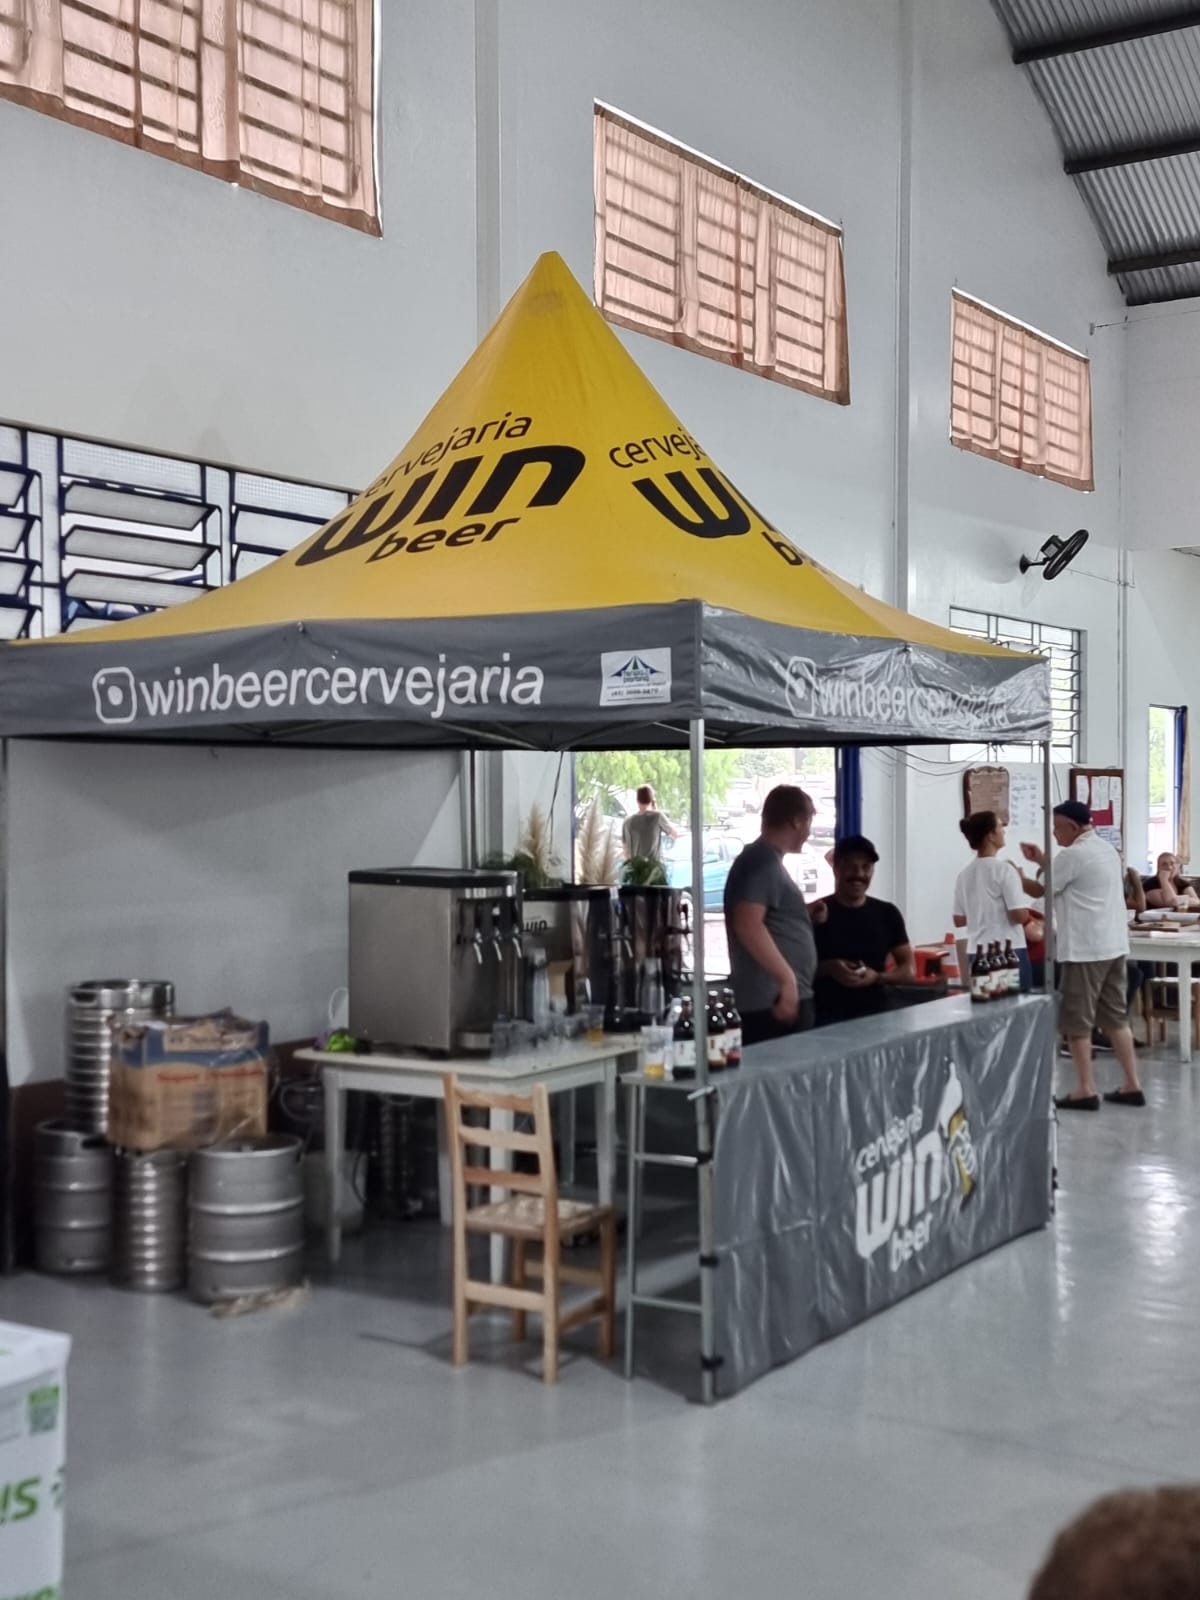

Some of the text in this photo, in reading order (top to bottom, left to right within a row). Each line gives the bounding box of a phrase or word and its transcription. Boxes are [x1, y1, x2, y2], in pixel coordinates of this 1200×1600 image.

[347, 411, 533, 506] ervejaria
[295, 444, 586, 567] win
[364, 517, 522, 565] beer
[139, 652, 545, 719] winbeercervejaria
[855, 1130, 943, 1260] win
[890, 1211, 934, 1274] beer
